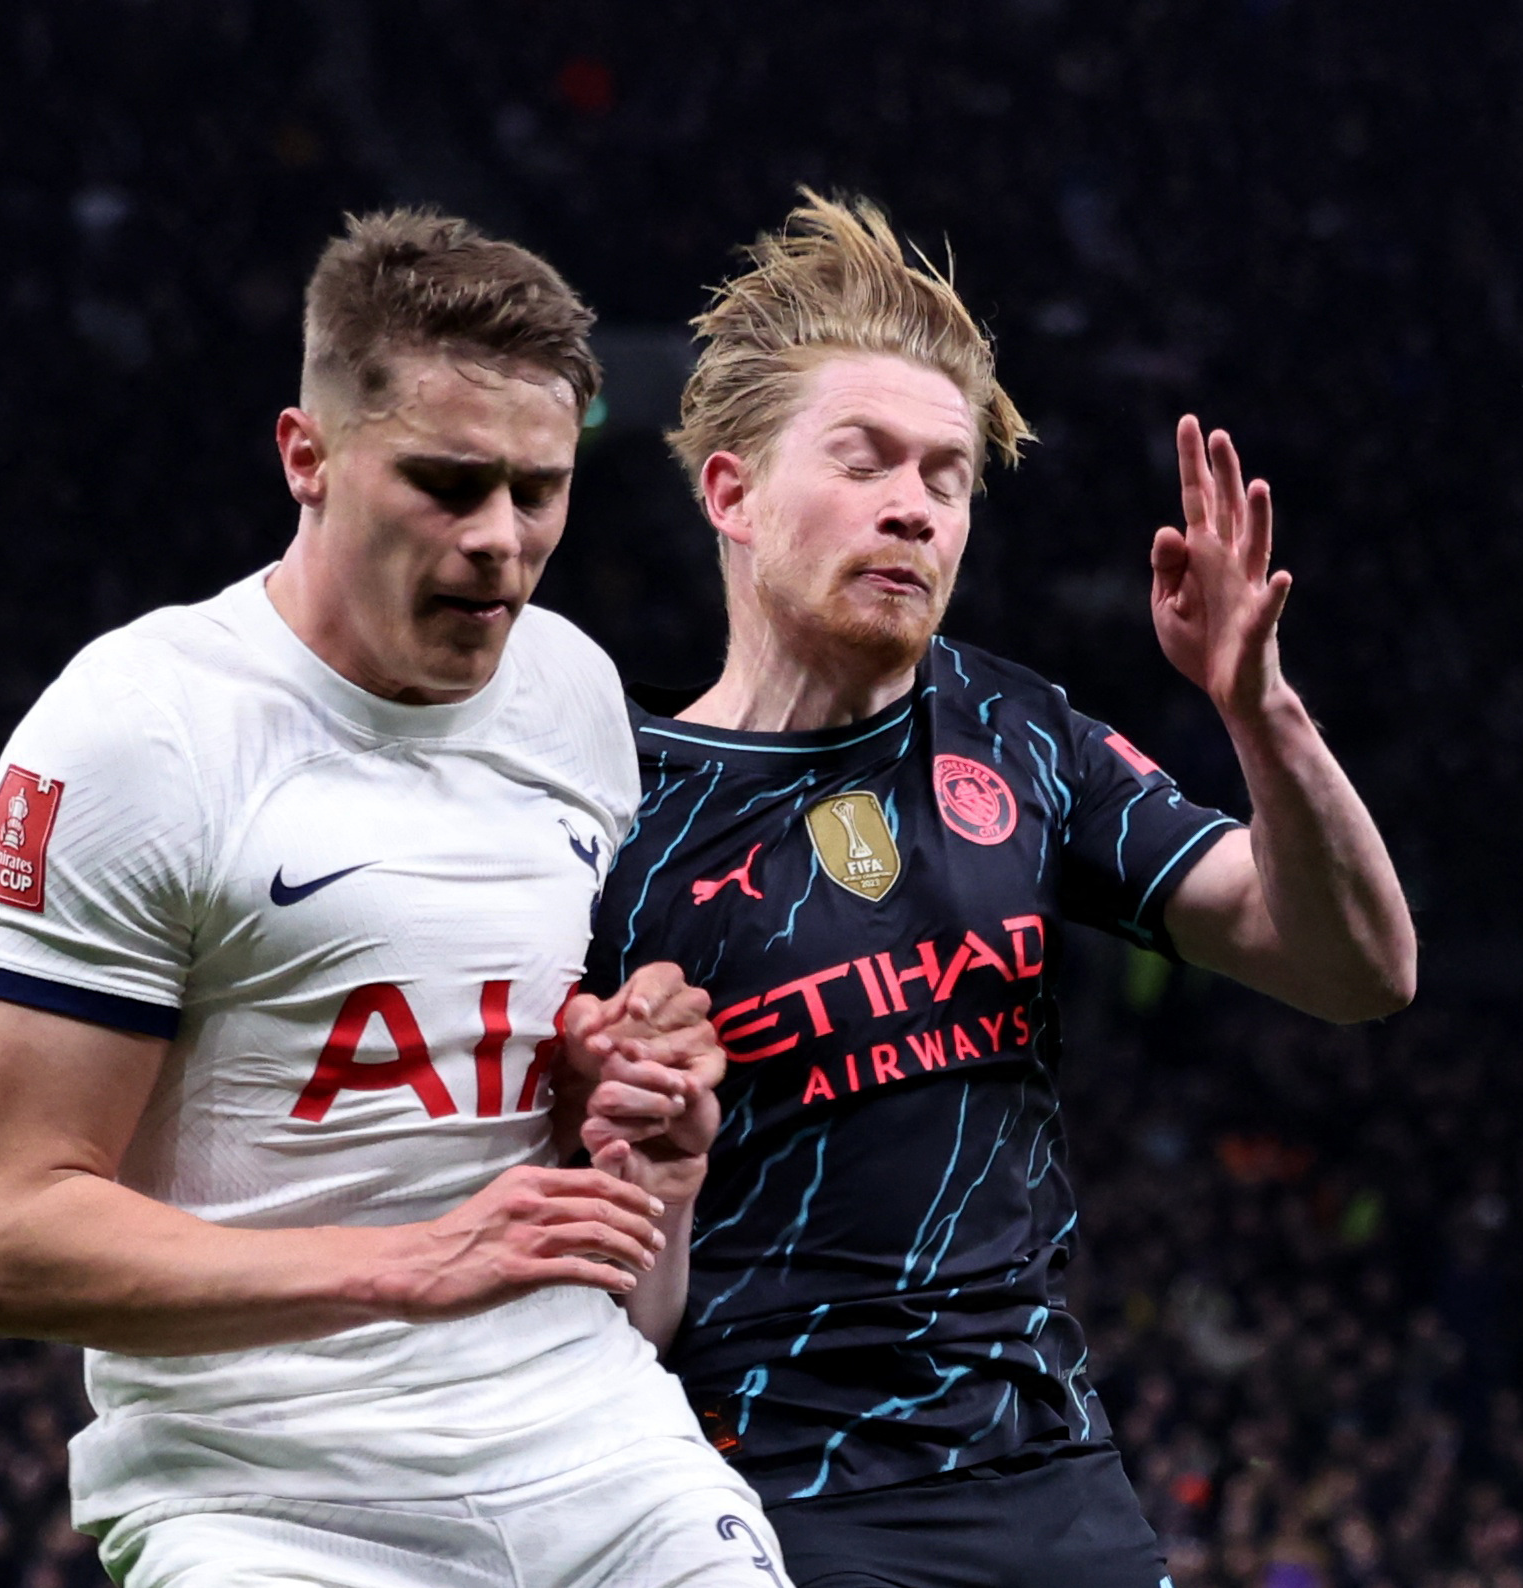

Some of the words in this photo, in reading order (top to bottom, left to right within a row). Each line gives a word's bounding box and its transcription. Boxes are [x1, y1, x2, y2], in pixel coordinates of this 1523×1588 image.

[0, 867, 33, 893] CUP
[846, 858, 884, 876] FIFA
[711, 914, 1044, 1063] ETIHAD
[802, 1005, 1030, 1104] AIRWAYS
